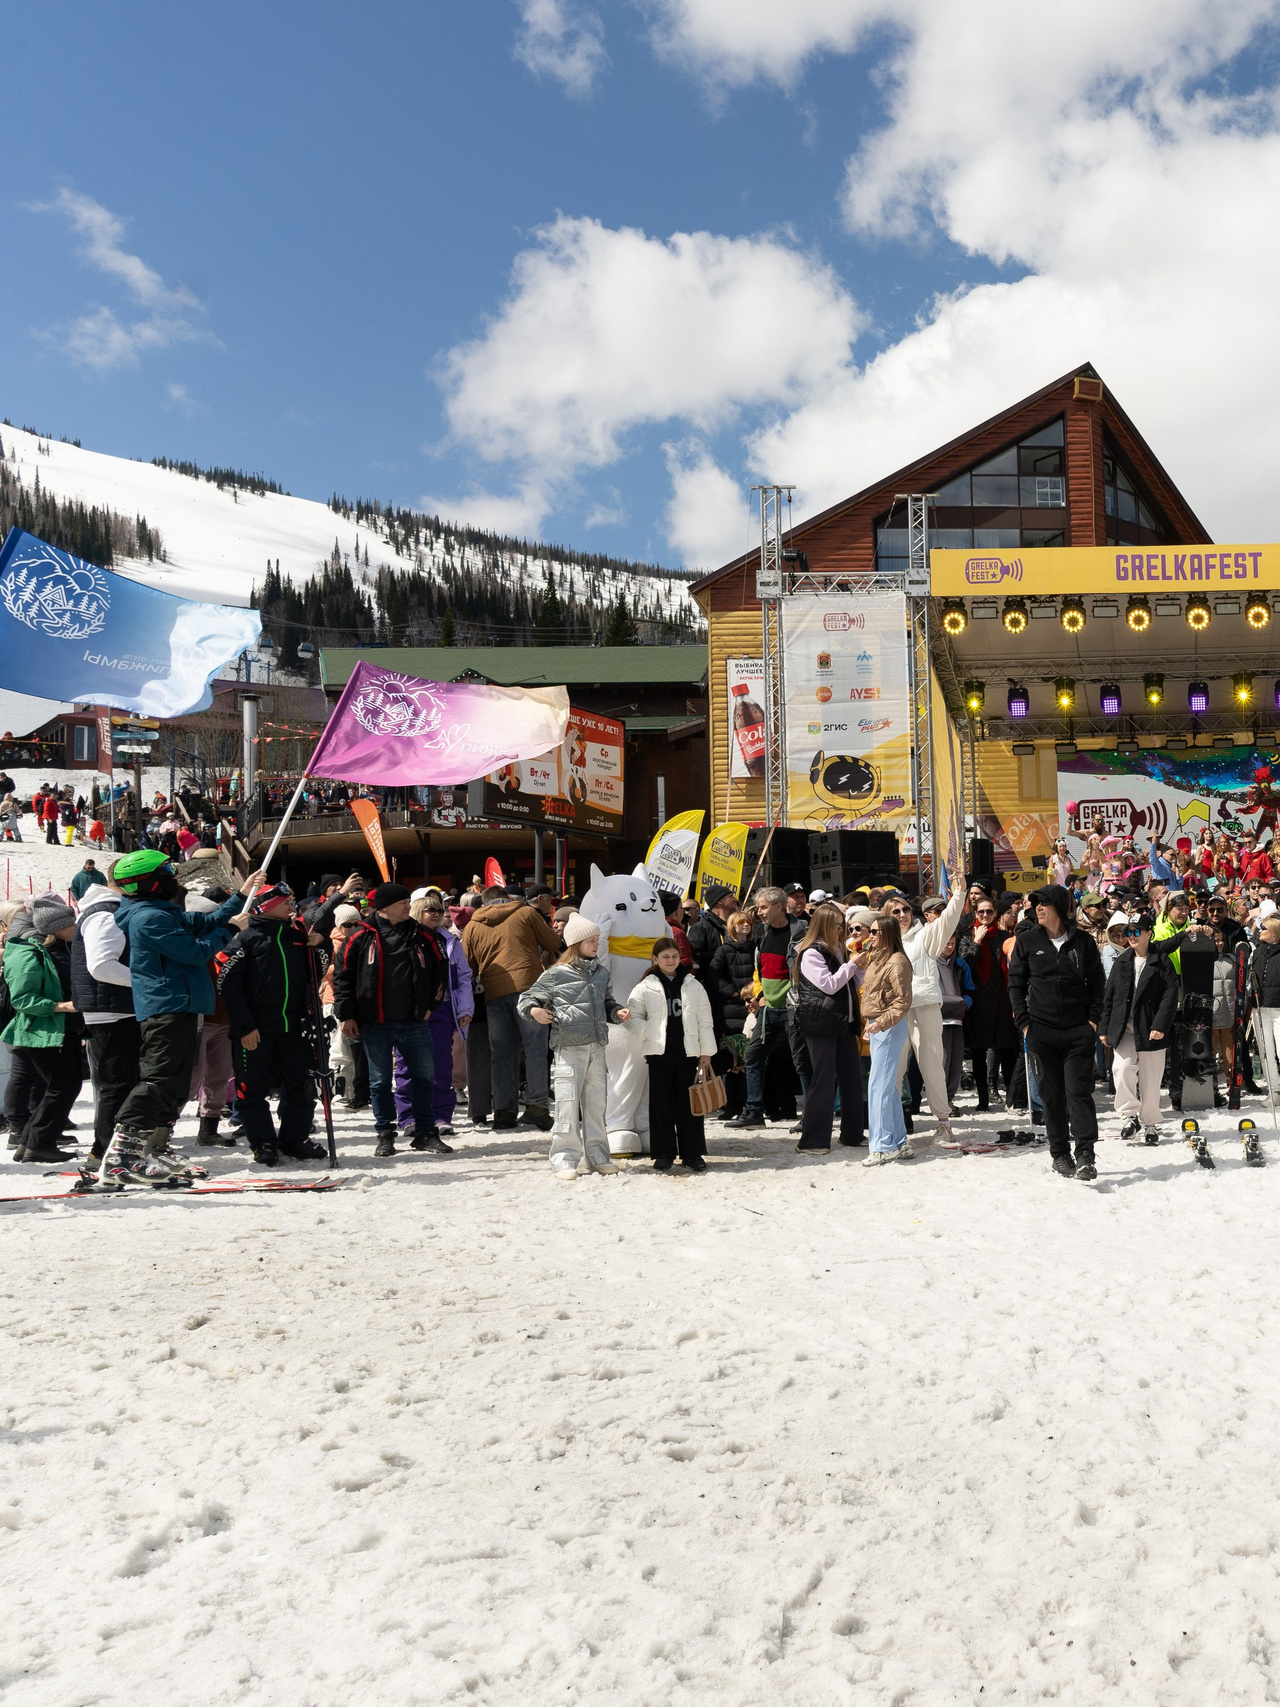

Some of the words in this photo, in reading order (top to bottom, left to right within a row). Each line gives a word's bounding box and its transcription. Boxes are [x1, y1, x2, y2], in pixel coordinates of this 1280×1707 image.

[970, 561, 999, 571] GRELKA
[1116, 553, 1262, 581] GRELKAFEST
[971, 571, 990, 580] FEST
[849, 687, 881, 700] AYS!
[581, 717, 597, 729] УЖЕ
[597, 723, 605, 731] 10
[605, 724, 619, 735] ЛЕТ!
[823, 723, 848, 732] 2ГИС
[544, 799, 577, 818] GRELKA
[1083, 805, 1127, 819] GRELKA
[998, 813, 1035, 850] Cola
[649, 872, 685, 898] GRELKA
